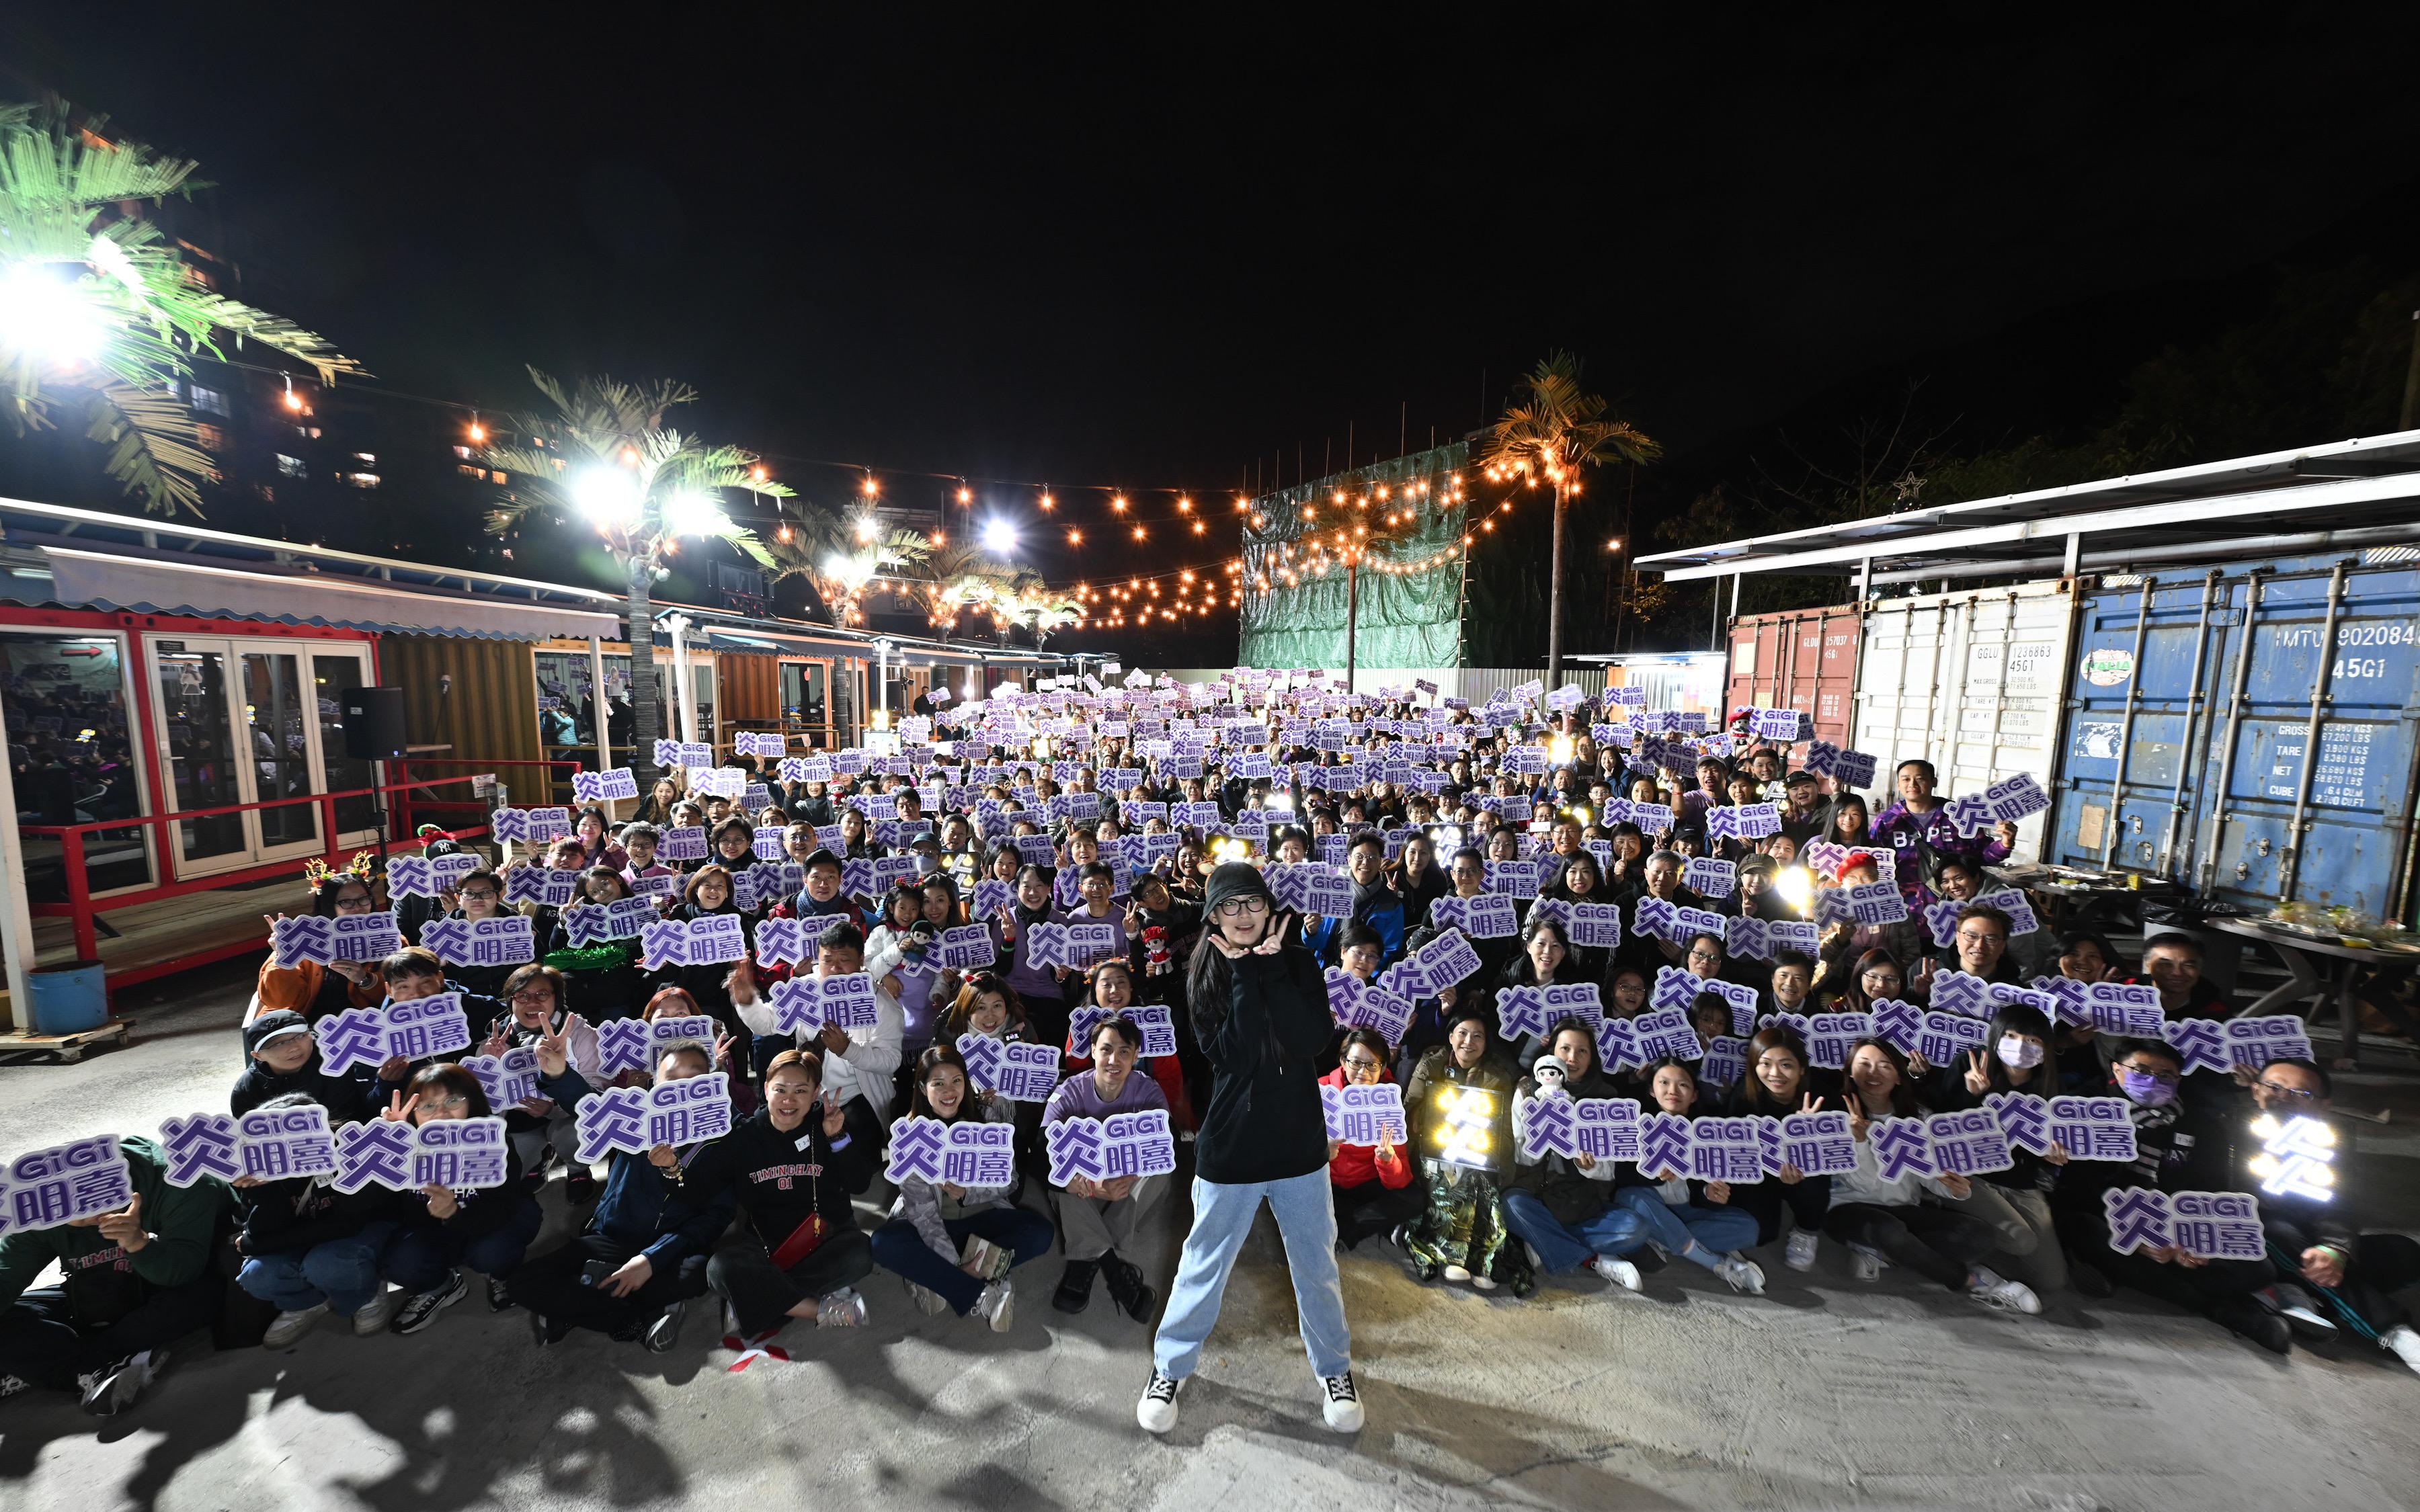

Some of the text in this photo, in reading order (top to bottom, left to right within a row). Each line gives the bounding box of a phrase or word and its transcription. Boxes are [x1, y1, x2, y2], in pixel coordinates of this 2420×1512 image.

[1826, 636, 1847, 646] 057037
[2337, 625, 2415, 646] 902084
[1978, 646, 2051, 659] GGLU 1236863
[2010, 660, 2033, 672] 45G1
[2332, 658, 2385, 679] 45G1
[1764, 710, 1798, 722] GiGi
[2278, 726, 2310, 735] GROSS
[2354, 724, 2373, 733] KGS
[2353, 734, 2371, 743] LBS
[1840, 751, 1875, 768] GiGi
[2277, 746, 2302, 756] TARE
[2351, 746, 2369, 755] KGS
[2349, 755, 2367, 765] LBS
[804, 758, 828, 767] GiGi
[1329, 767, 1353, 776] GiGi
[2273, 765, 2293, 775] NET
[2347, 767, 2365, 775] KGS
[601, 769, 631, 782] GiGi
[2345, 776, 2363, 786] LBS
[1985, 774, 2033, 801] GiGi
[2269, 786, 2295, 797] CUBE
[1072, 794, 1096, 804] GiGi
[1740, 804, 1776, 817] GiGi
[1946, 794, 2004, 836] 炎
[1498, 862, 1535, 876] GiGi
[1311, 876, 1351, 892] GiGi
[1469, 895, 1510, 911] GiGi
[1574, 905, 1617, 921] GiGi
[335, 914, 393, 933] GiGi
[475, 918, 528, 935] GiGi
[689, 917, 738, 935] GiGi
[277, 918, 338, 966] 炎
[423, 920, 475, 966] 炎
[643, 922, 693, 967] 炎
[1419, 931, 1462, 966] GiGi
[822, 976, 871, 996] GiGi
[1383, 960, 1439, 1011] 炎
[2091, 985, 2156, 1006] GiGi
[388, 995, 458, 1025] GiGi
[773, 978, 827, 1033] 炎
[1635, 1011, 1685, 1034] GiGi
[318, 1010, 395, 1072] 炎
[1591, 1020, 1650, 1070] 炎
[1005, 1045, 1057, 1067] GiGi
[651, 1077, 723, 1107] GiGi
[1577, 1102, 1637, 1122] GiGi
[2052, 1100, 2126, 1122] GiGi
[241, 1111, 323, 1137] GiGi
[579, 1090, 653, 1159] 炎
[1105, 1114, 1166, 1139] GiGi
[1523, 1099, 1581, 1154] 炎
[1694, 1121, 1755, 1142] GiGi
[1929, 1111, 1996, 1138] GiGi
[1986, 1095, 2056, 1152] 炎
[418, 1123, 501, 1147] GiGi
[949, 1126, 1010, 1147] GiGi
[1640, 1116, 1697, 1175] 炎
[14, 1138, 114, 1181] GiGi
[163, 1116, 249, 1182] 炎
[337, 1123, 417, 1188] 炎
[887, 1120, 945, 1179] 炎
[1049, 1120, 1110, 1181] 炎
[1870, 1120, 1942, 1179] 炎
[778, 1177, 793, 1190] 01
[2174, 1195, 2253, 1218] GiGi
[2107, 1190, 2180, 1249] 炎
